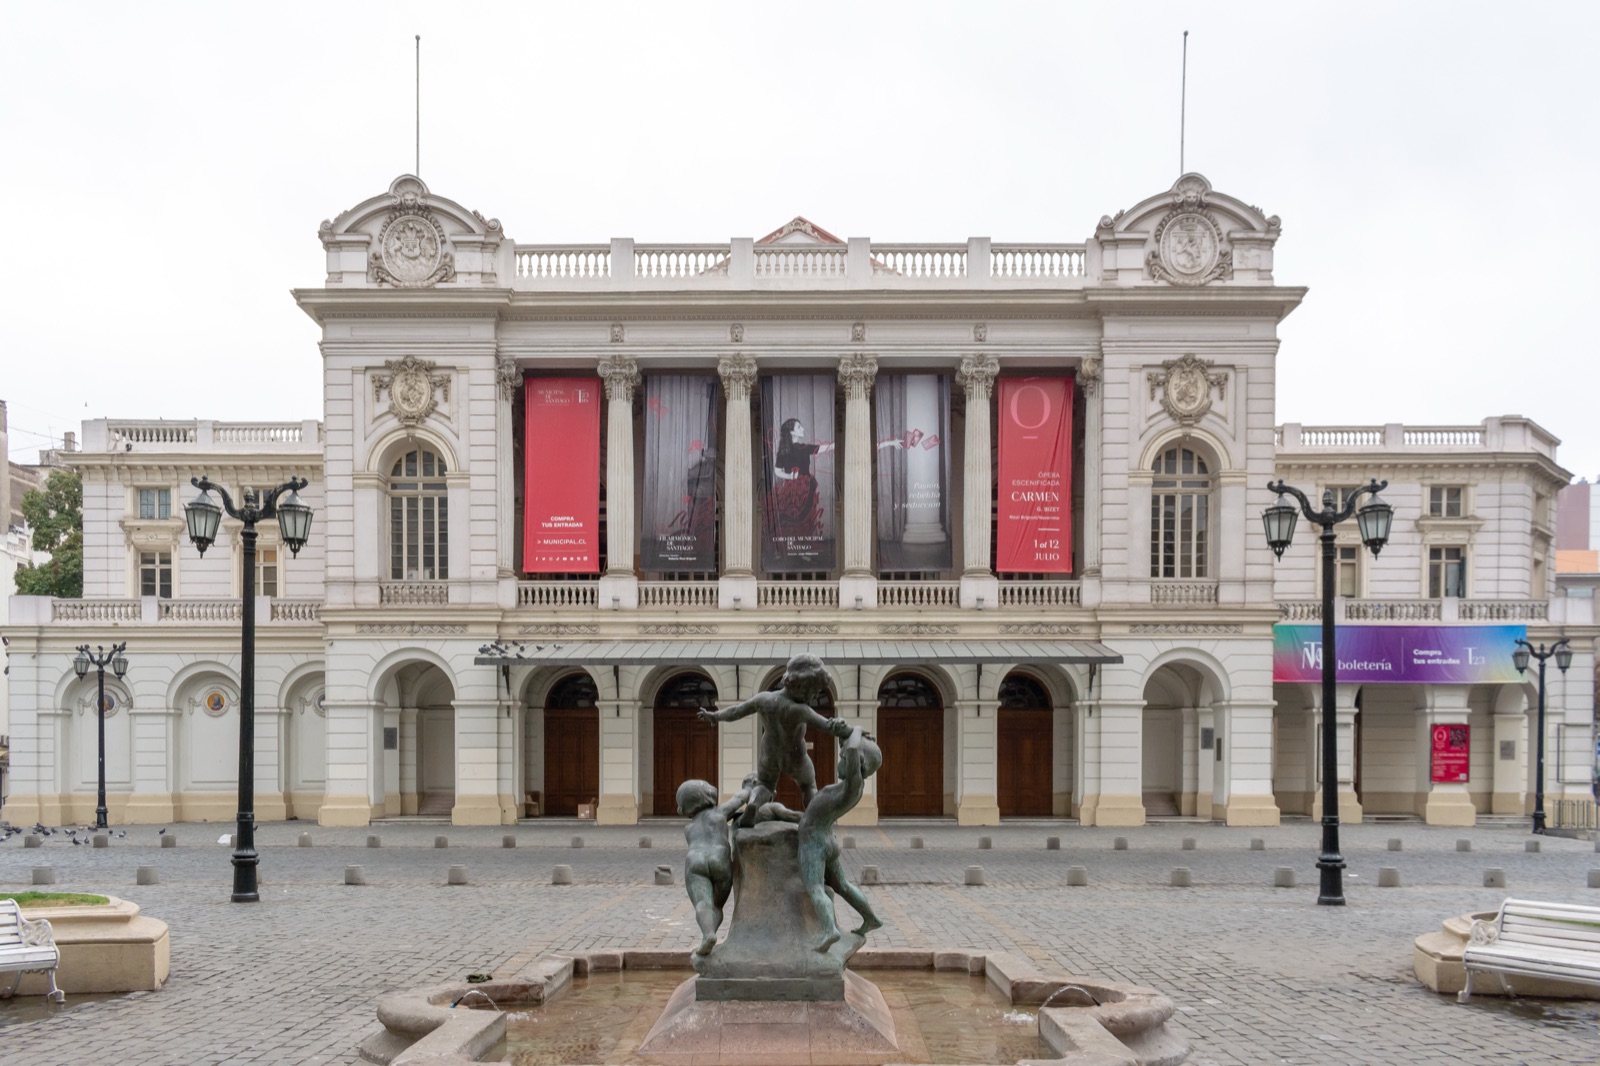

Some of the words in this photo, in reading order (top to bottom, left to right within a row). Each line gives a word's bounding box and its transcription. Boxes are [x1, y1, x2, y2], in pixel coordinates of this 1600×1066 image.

[1011, 491, 1059, 502] CARMEN
[1034, 539, 1038, 548] 1
[1049, 539, 1060, 549] 12
[1034, 552, 1060, 561] JULIO
[1413, 648, 1442, 657] Compra
[1337, 658, 1392, 671] boletería
[1413, 657, 1426, 665] tus
[1426, 657, 1460, 665] entradas
